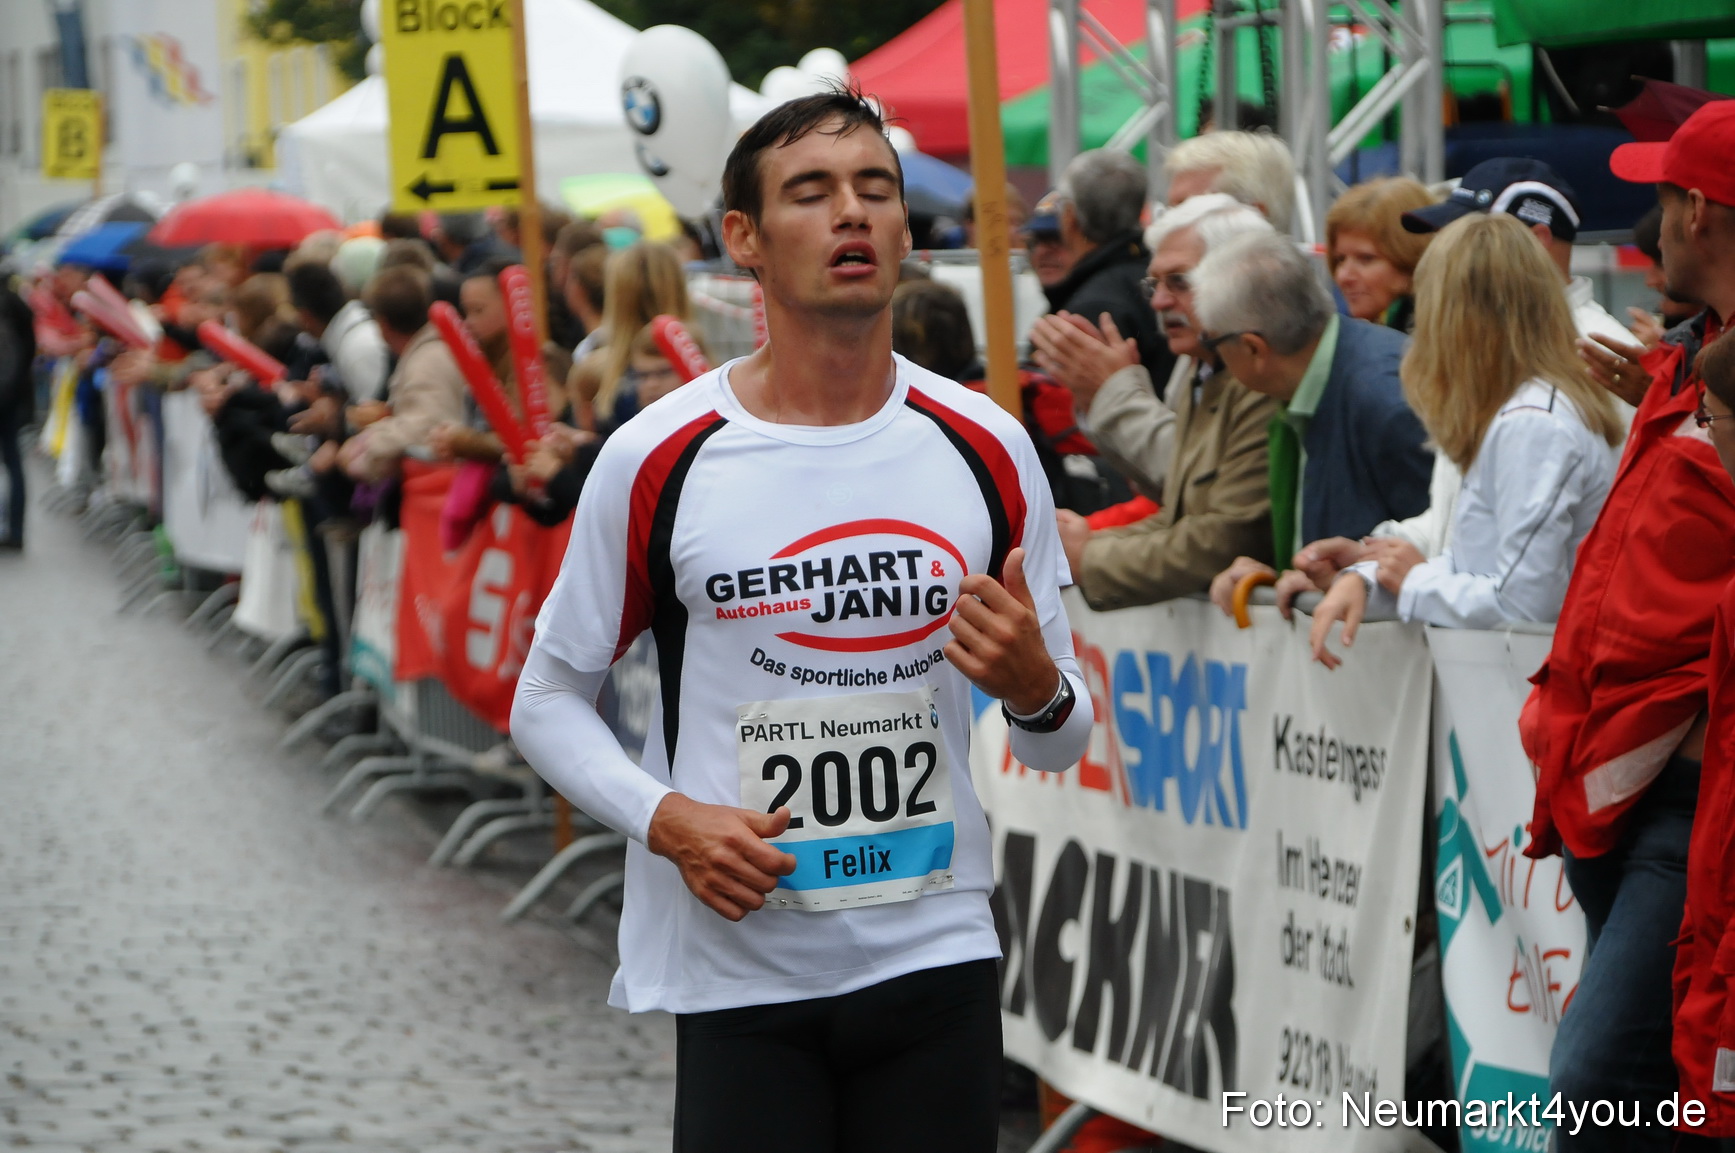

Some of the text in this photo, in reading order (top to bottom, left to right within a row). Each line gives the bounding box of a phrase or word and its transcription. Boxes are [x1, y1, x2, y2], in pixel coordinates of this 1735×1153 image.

[396, 0, 512, 32] Block
[420, 52, 503, 159] A
[705, 549, 946, 603] GERHART &
[714, 584, 949, 624] Autohaus JÄNIG
[749, 646, 945, 687] Das sportliche Autoha
[740, 712, 923, 743] PARTL Neumarkt
[761, 741, 938, 830] 2002
[823, 845, 893, 880] Felix
